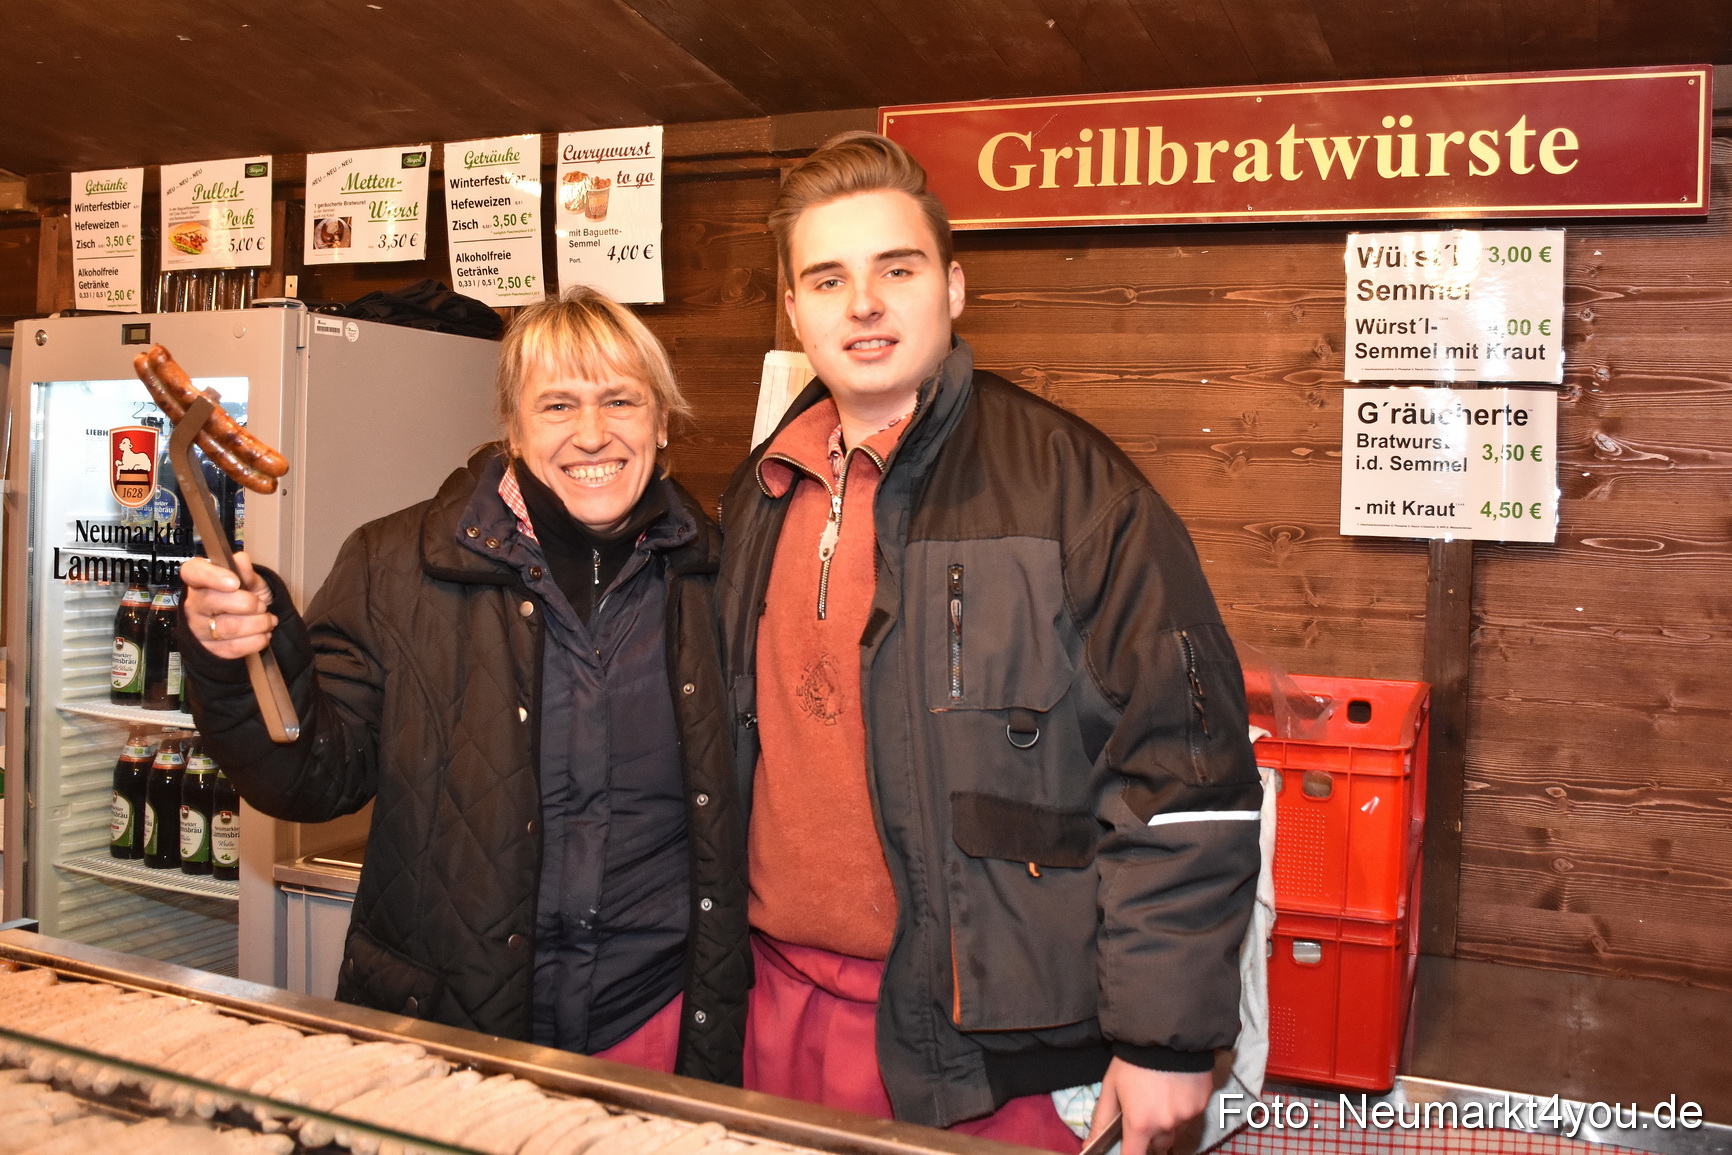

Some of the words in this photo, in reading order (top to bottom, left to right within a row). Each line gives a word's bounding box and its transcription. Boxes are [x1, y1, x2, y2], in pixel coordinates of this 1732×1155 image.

[464, 147, 520, 170] Getränke
[563, 141, 651, 164] Currywurst
[977, 114, 1579, 192] Grillbratwürste
[312, 177, 322, 186] NEU
[326, 167, 338, 177] NEU
[341, 158, 353, 168] NEU
[616, 170, 632, 185] to
[635, 172, 655, 189] go
[85, 177, 128, 196] Getränke
[166, 187, 176, 196] NEU
[178, 178, 189, 187] NEU
[192, 168, 203, 178] NEU
[192, 180, 245, 201] Pulled-
[341, 172, 402, 191] Metten-
[74, 200, 131, 212] Winterfestbier
[451, 196, 511, 210] Hefeweizen
[74, 219, 119, 231] Hefeweizen
[452, 218, 479, 231] Zisch
[492, 213, 517, 230] 3,50
[76, 239, 96, 249] Zisch
[106, 235, 124, 248] 3,50
[378, 234, 407, 251] 3,50
[410, 232, 418, 246] €
[568, 229, 581, 237] mit
[583, 228, 622, 238] Baguette-
[228, 237, 254, 254] 5,00
[256, 236, 265, 251] €
[568, 239, 601, 248] Semmel
[455, 250, 512, 263] Alkoholfreie
[607, 245, 639, 264] 4,00
[643, 244, 654, 260] €
[1488, 246, 1531, 266] 3,00
[1538, 246, 1552, 263] €
[78, 266, 119, 277] Alkoholfreie
[456, 265, 499, 277] Getränke
[78, 280, 109, 290] Getränke
[458, 280, 472, 288] 0,33
[481, 279, 492, 287] 0,5
[497, 275, 522, 291] 2,50
[107, 290, 124, 303] 2,50
[1538, 318, 1551, 336] €
[1355, 342, 1437, 360] Semmel
[1445, 342, 1479, 360] mit
[1482, 443, 1524, 464] 3,50
[1530, 444, 1543, 462] €
[1355, 455, 1383, 471] i.d.
[1389, 456, 1467, 473] Semmel
[122, 487, 144, 500] 1628
[1366, 500, 1395, 516] mit
[1402, 500, 1455, 517] Kraut
[1480, 501, 1523, 521] 4,50
[1529, 502, 1542, 519] €
